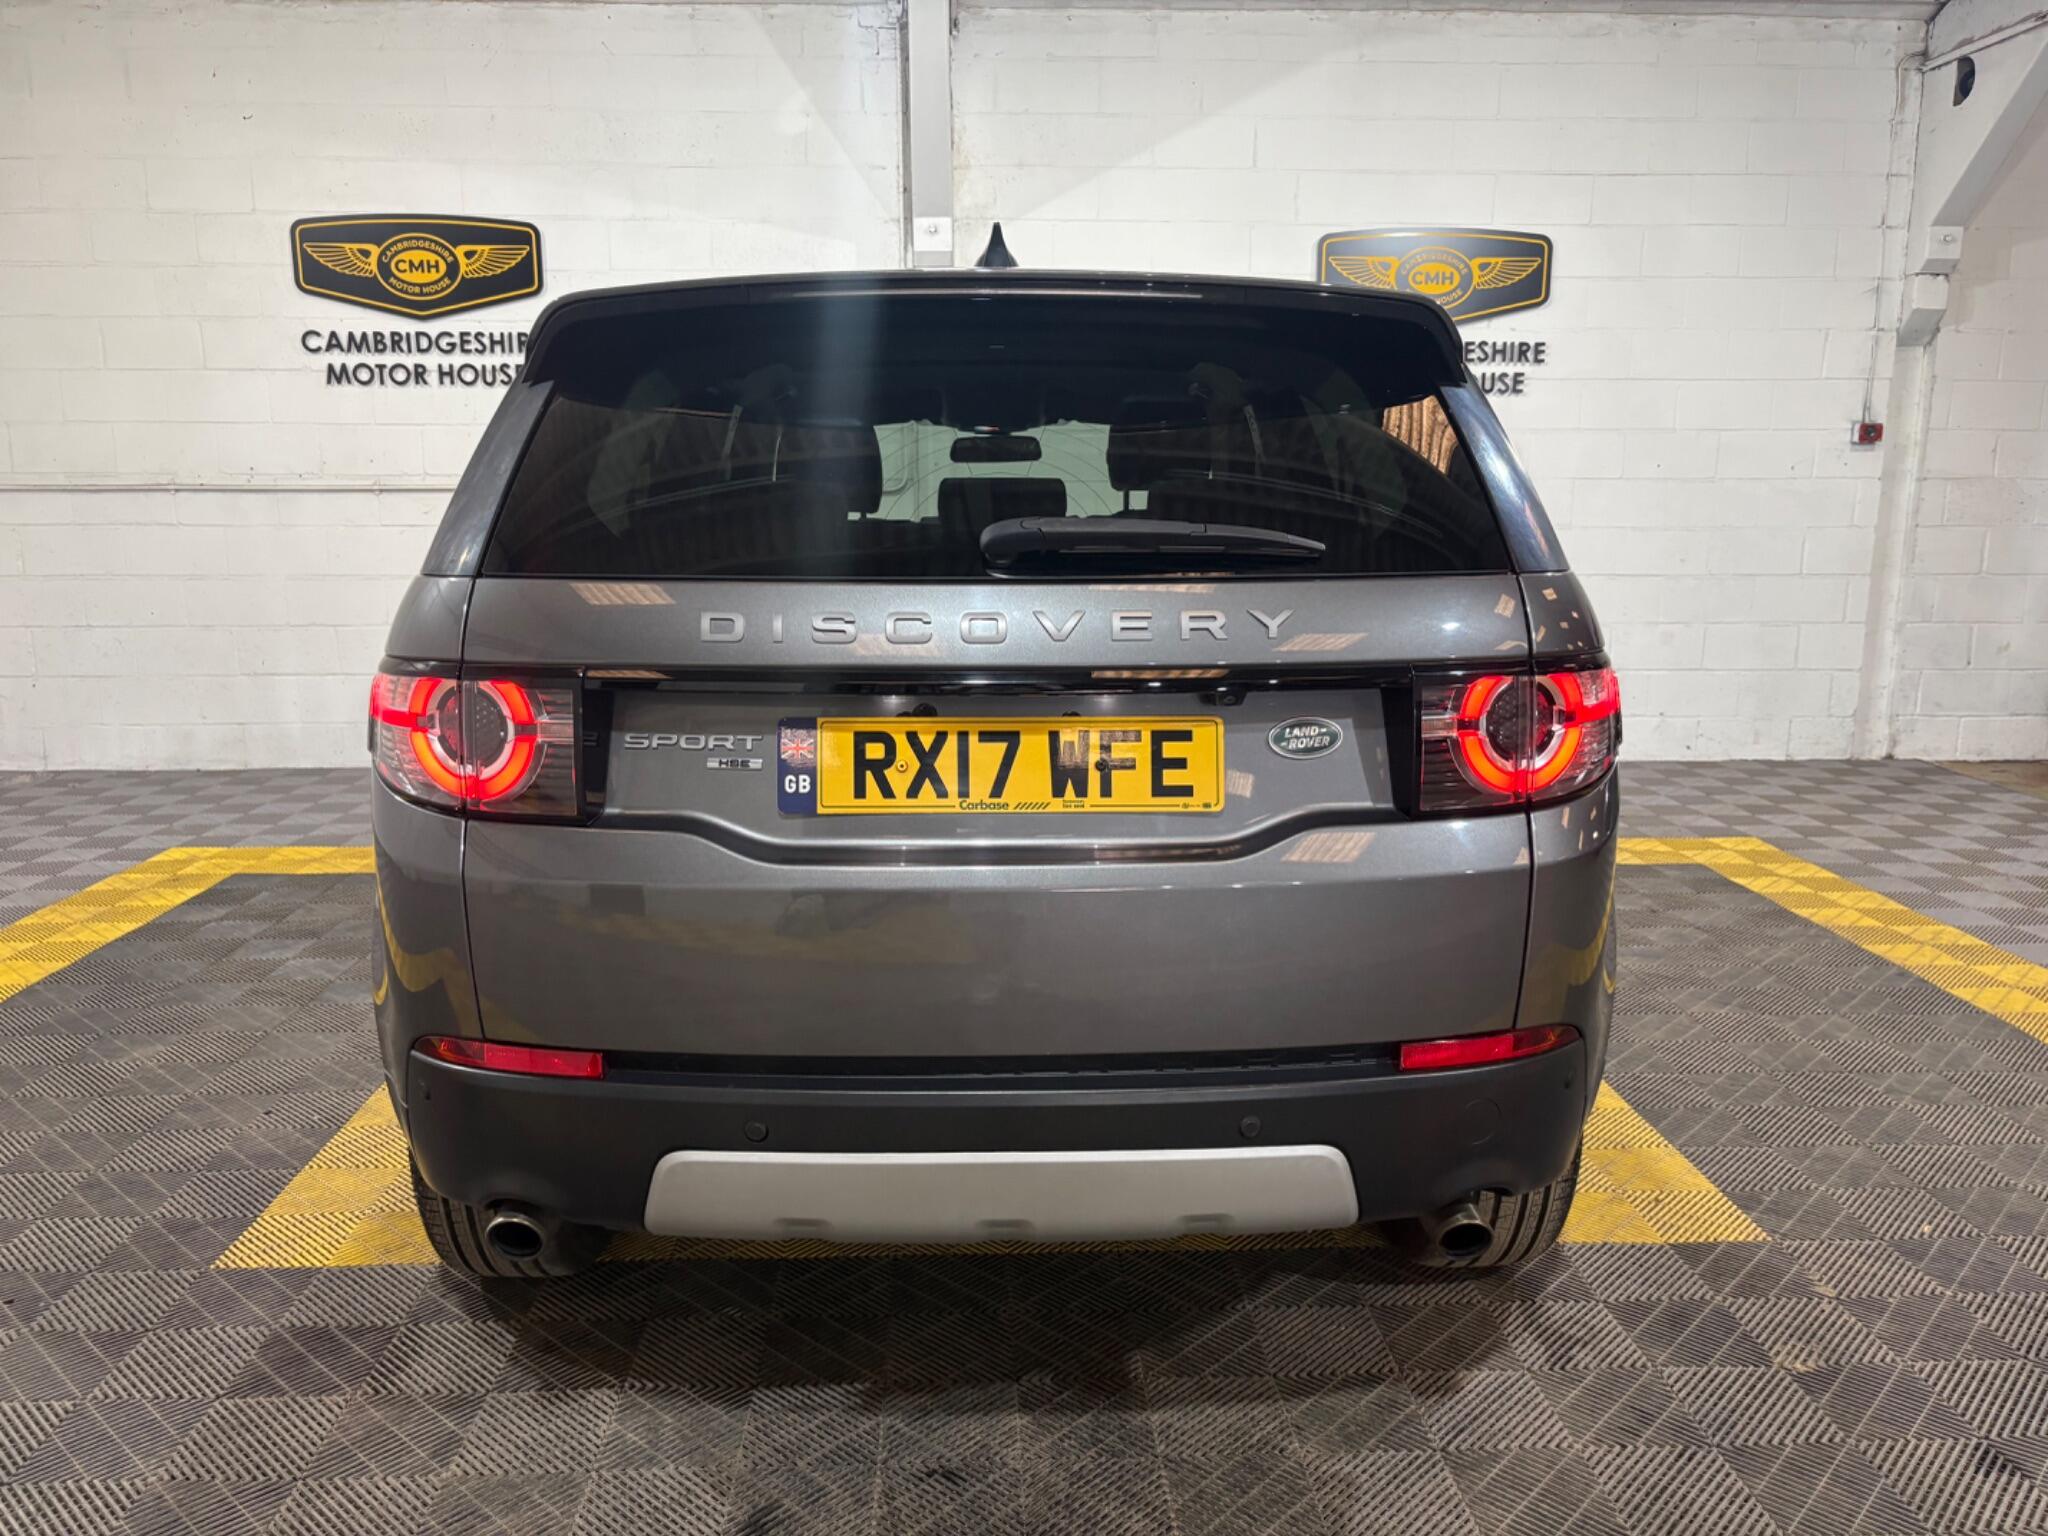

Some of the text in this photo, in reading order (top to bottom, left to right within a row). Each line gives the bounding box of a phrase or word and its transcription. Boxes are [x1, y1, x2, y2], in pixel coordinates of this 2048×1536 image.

[394, 259, 440, 273] CMH
[388, 277, 420, 293] MOTOR
[1412, 271, 1454, 286] CMH
[301, 329, 528, 354] CAMBRIDGESHIR
[1464, 341, 1546, 363] ESHIRE
[326, 362, 428, 386] MOTOR
[1481, 372, 1525, 394] USE
[700, 607, 1295, 645] DISCOVERY
[624, 732, 763, 751] SPORT
[852, 729, 1195, 800] RX17 WFE
[784, 774, 811, 794] GB
[959, 800, 1010, 811] Carbase
